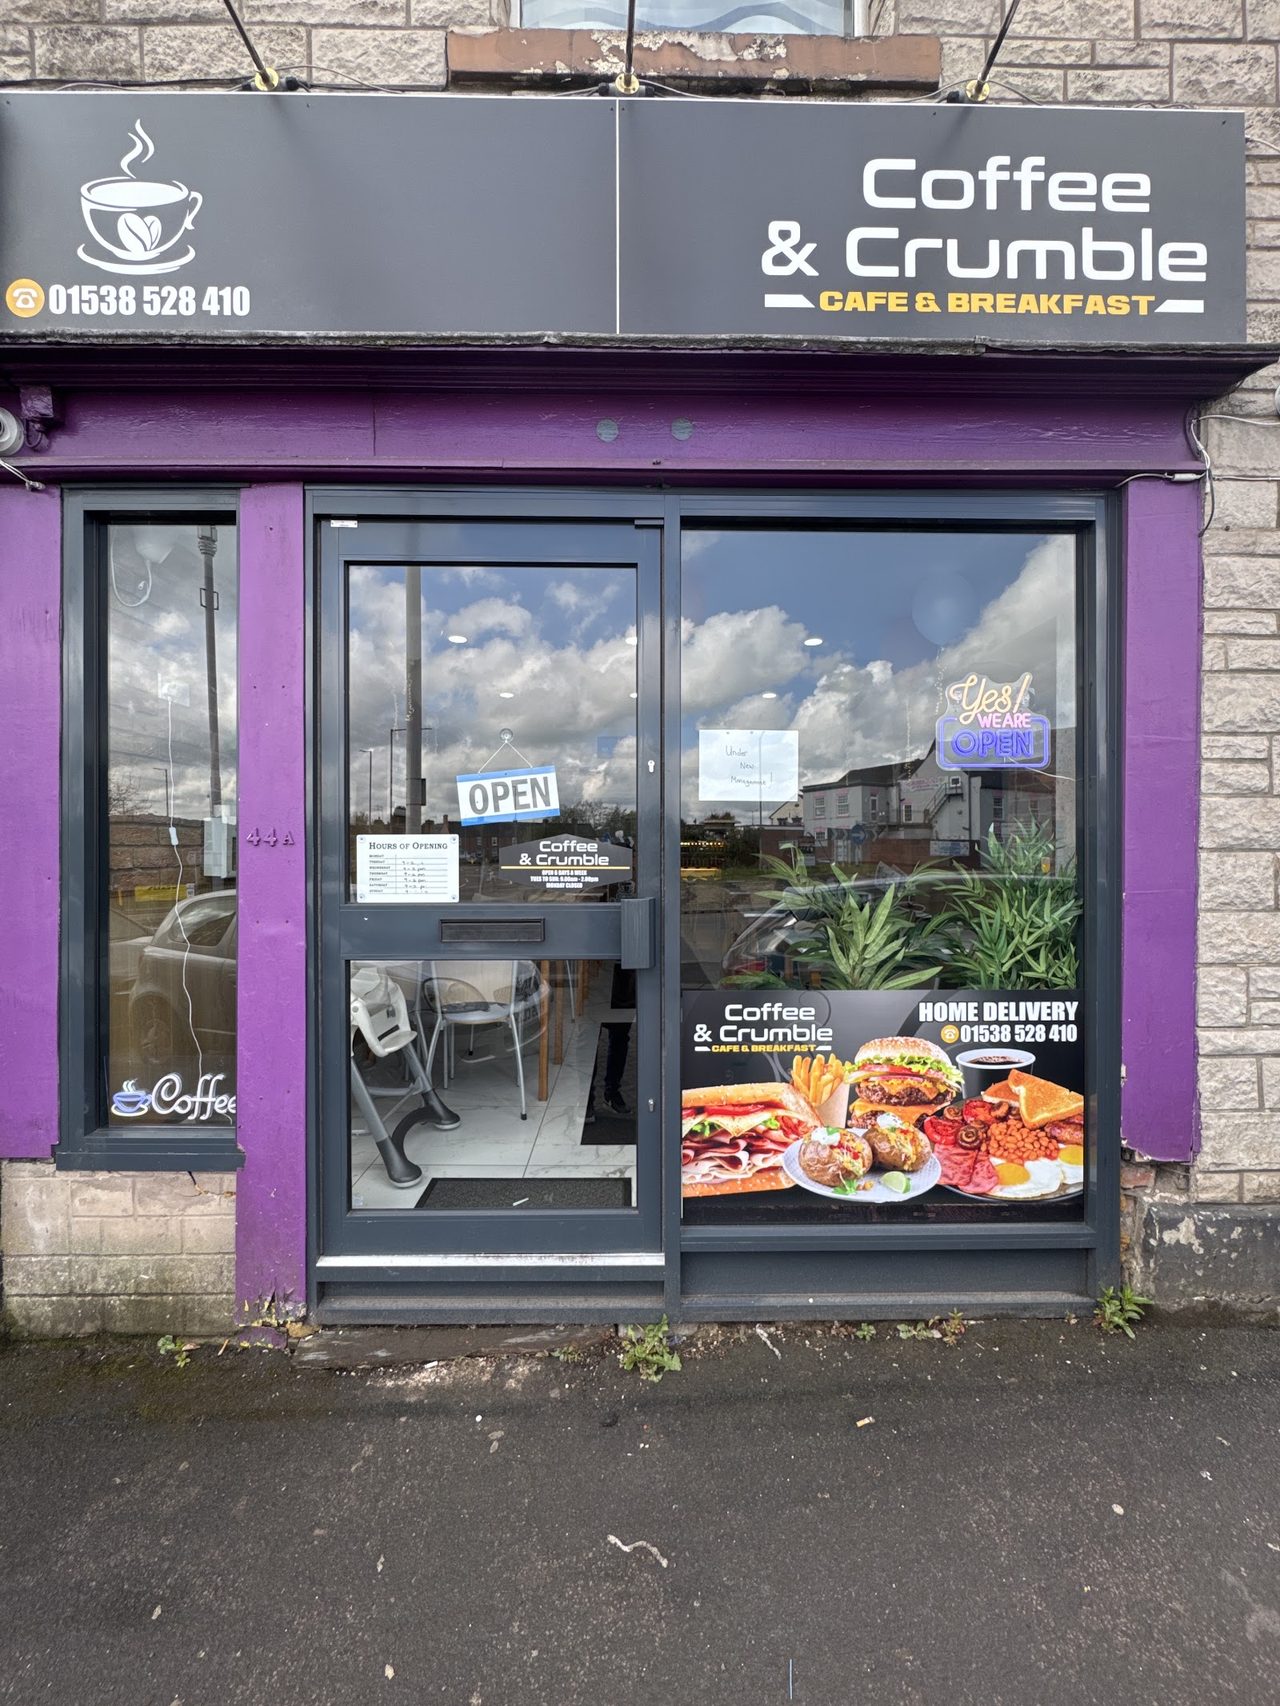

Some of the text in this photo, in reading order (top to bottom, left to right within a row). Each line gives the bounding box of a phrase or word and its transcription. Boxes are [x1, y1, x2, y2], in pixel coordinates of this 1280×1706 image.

[862, 155, 1151, 213] Coffee
[761, 220, 1208, 282] & Crumble
[48, 284, 251, 317] 01538 528 410
[819, 290, 1155, 315] CAFE & BREAKFAST
[948, 673, 1032, 725] Yes!
[951, 729, 1034, 758] OPEN
[468, 776, 551, 815] OPEN
[246, 827, 295, 847] 44A
[539, 840, 598, 852] Coffee
[519, 852, 609, 866] & Crumble
[724, 1002, 816, 1021] Coffee
[918, 1001, 1079, 1022] HOME DELIVERY
[693, 1023, 833, 1042] & Crumble
[960, 1024, 1078, 1043] 01538 528 410
[711, 1044, 740, 1053] CAFE
[750, 1044, 817, 1053] BREAKFAST
